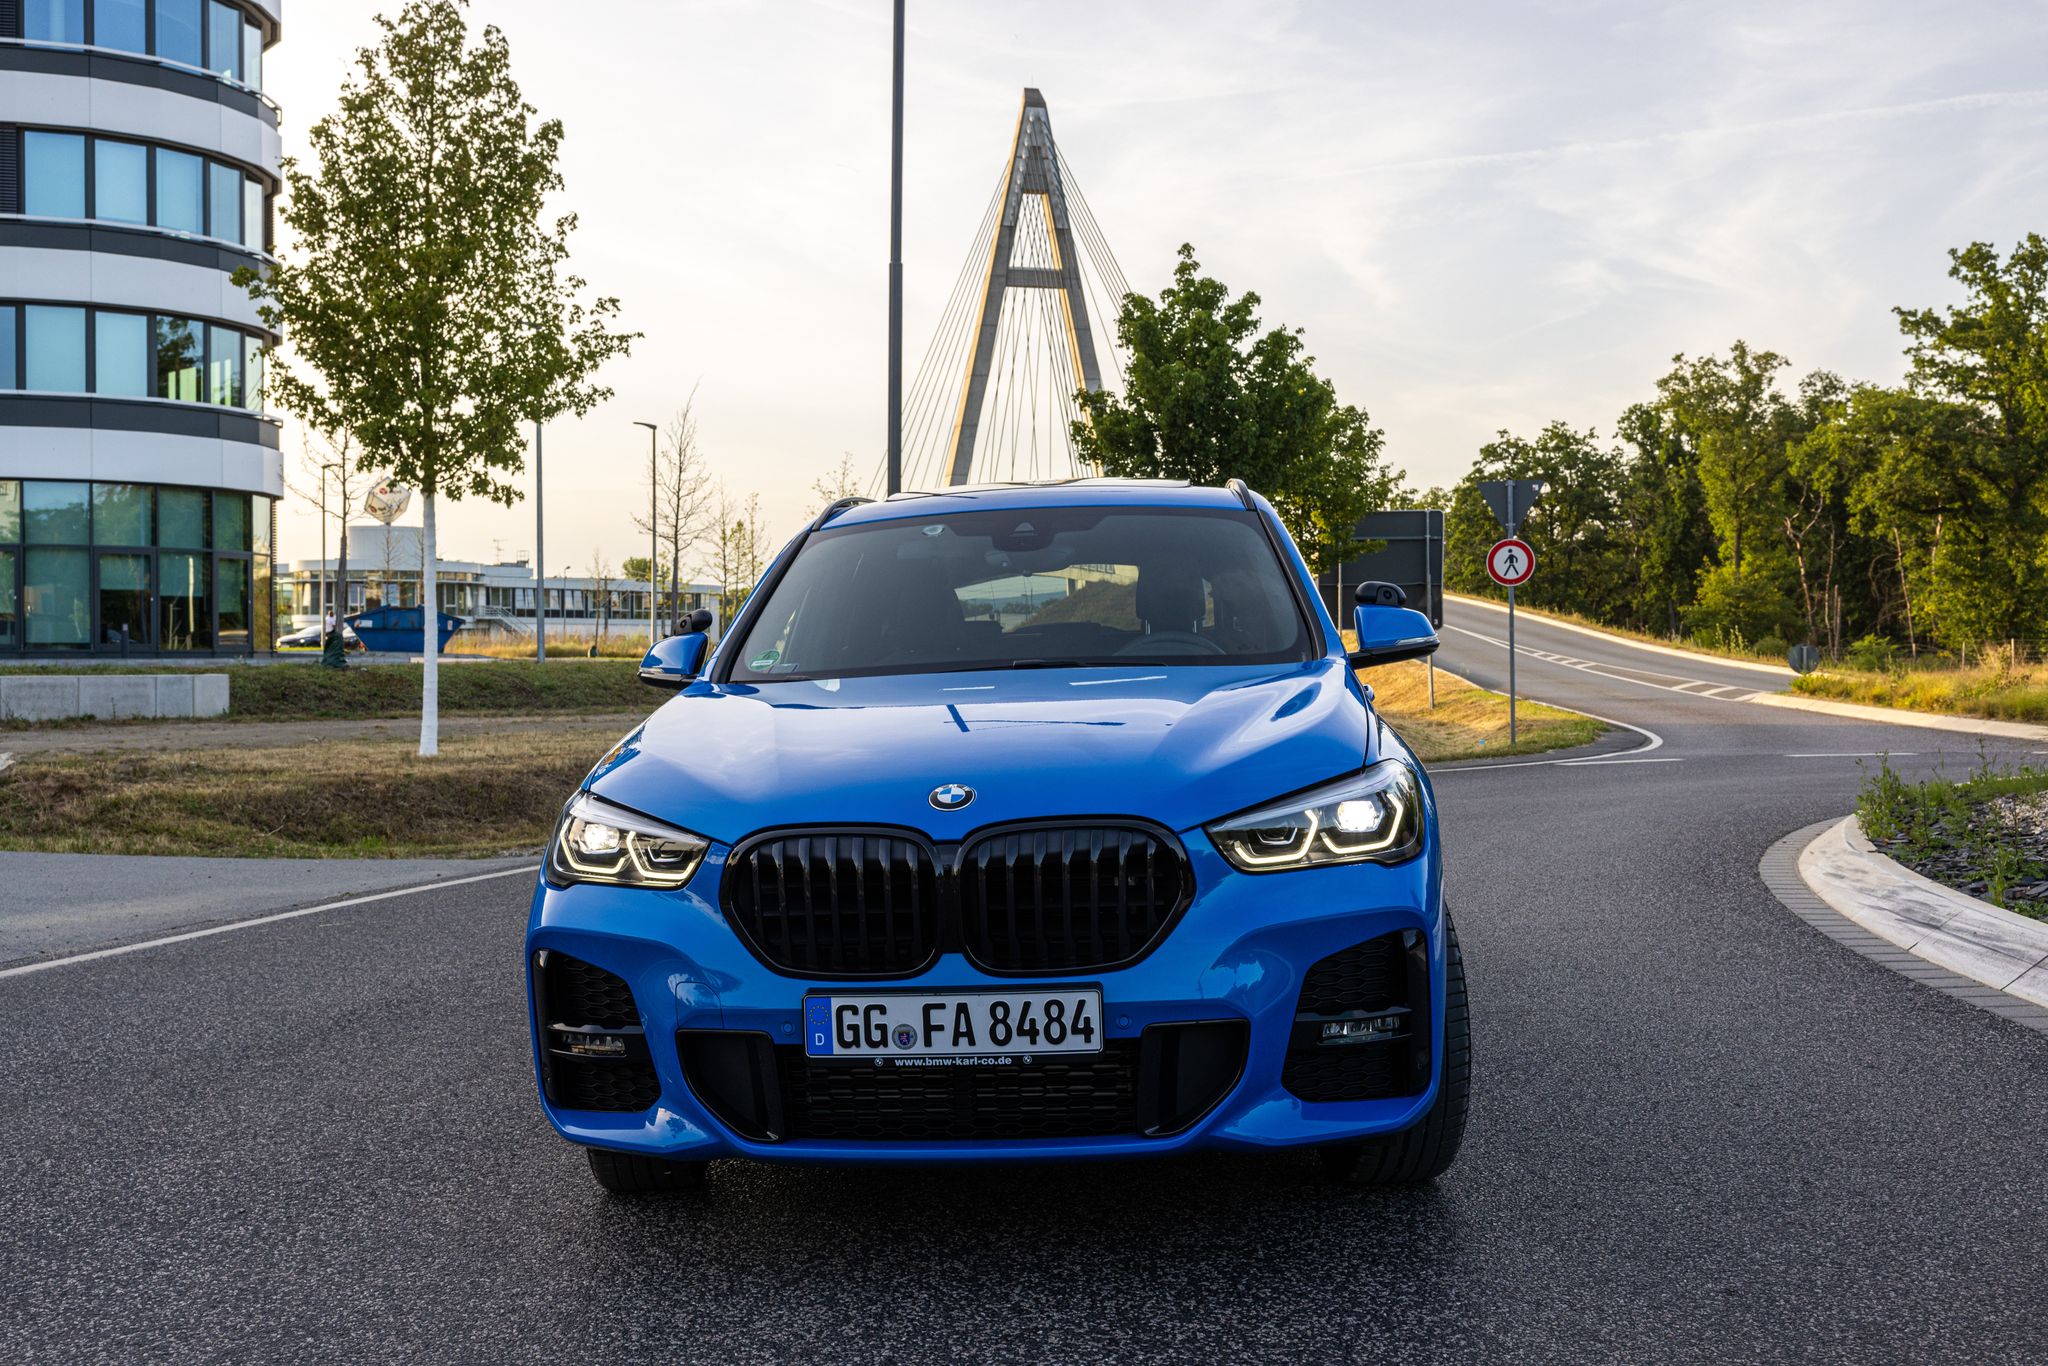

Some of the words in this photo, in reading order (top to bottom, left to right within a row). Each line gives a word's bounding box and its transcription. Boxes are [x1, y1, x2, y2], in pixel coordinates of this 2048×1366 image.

[835, 1004, 889, 1049] GG
[921, 1002, 977, 1048] FA
[989, 999, 1095, 1047] 8484
[815, 1033, 825, 1046] D
[894, 1056, 1012, 1067] www.bmw-karl-co.de
